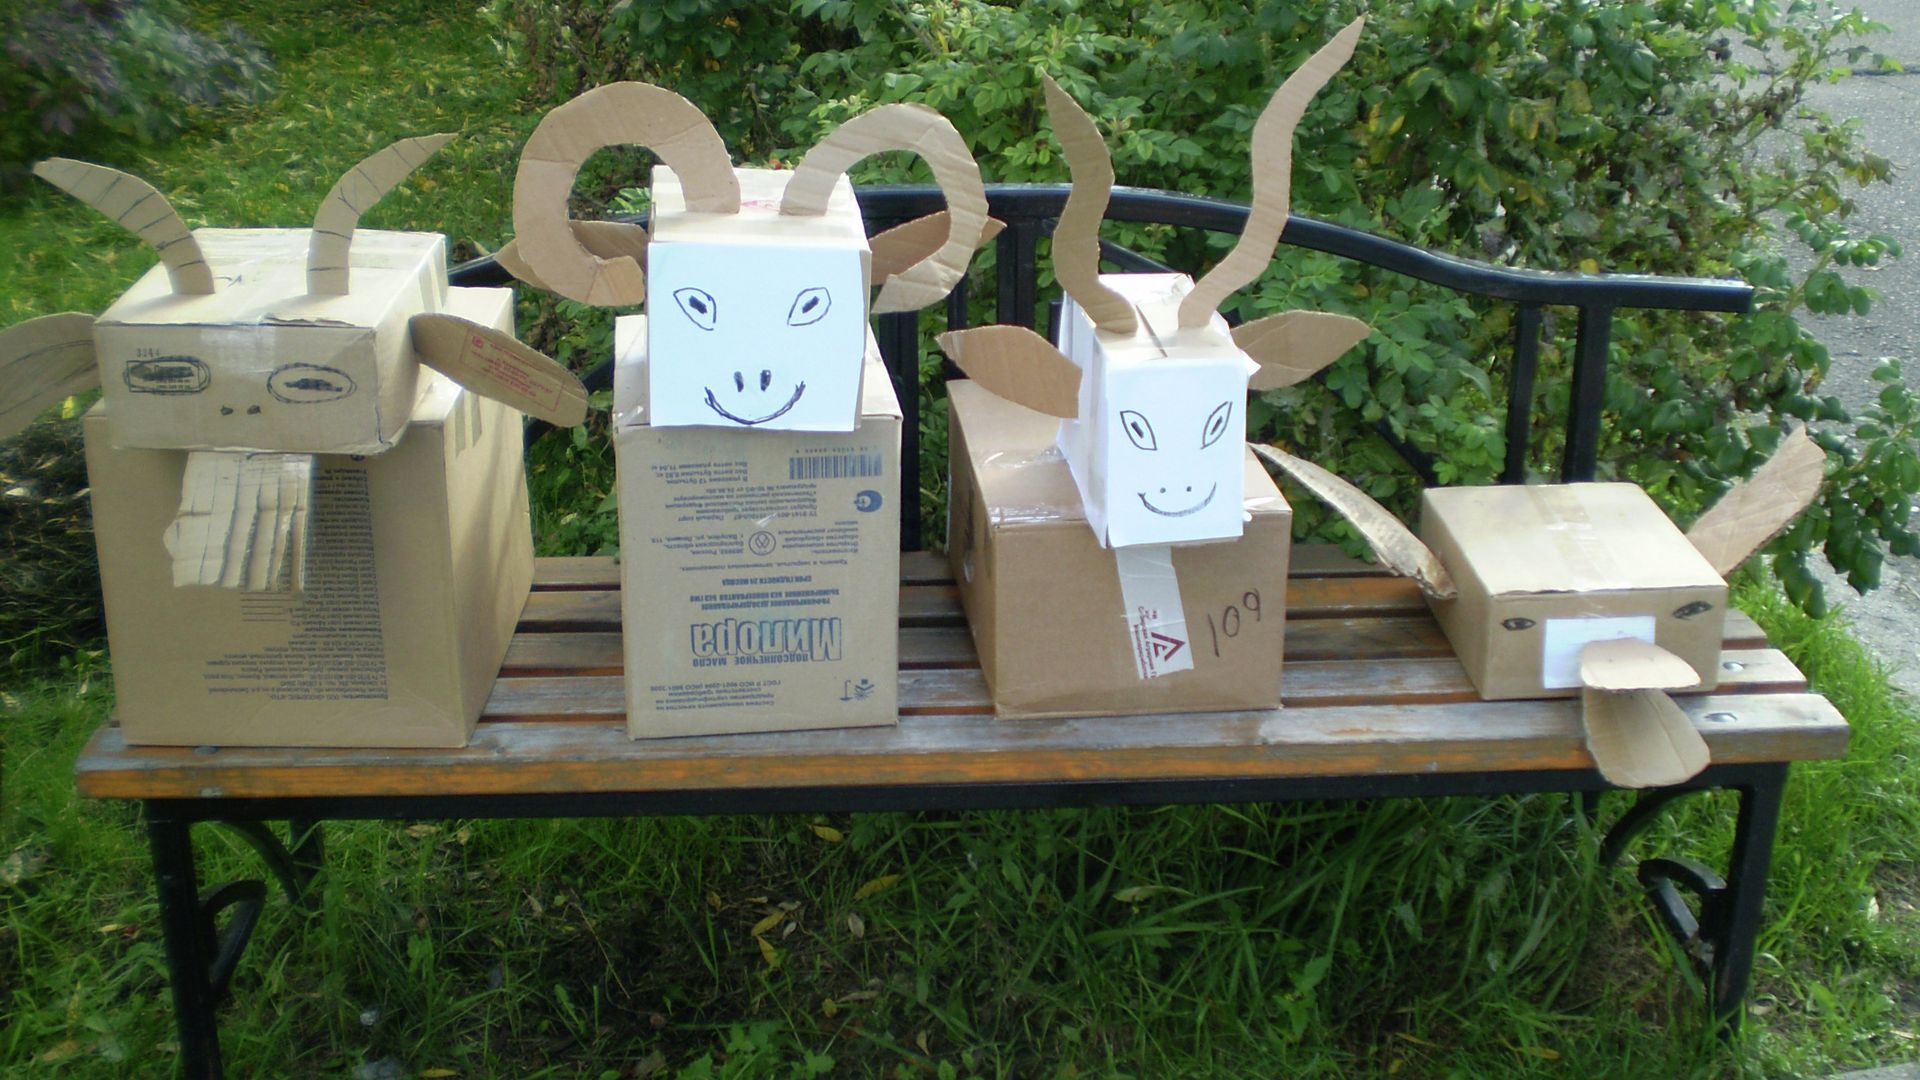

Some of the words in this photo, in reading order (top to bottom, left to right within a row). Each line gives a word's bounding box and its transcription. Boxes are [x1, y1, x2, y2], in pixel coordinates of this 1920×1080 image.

[1207, 587, 1261, 658] 109
[691, 617, 842, 661] Милора
[693, 657, 727, 667] МАСЛО
[734, 653, 808, 665] ПОДСОЛНЕЧНОЕ
